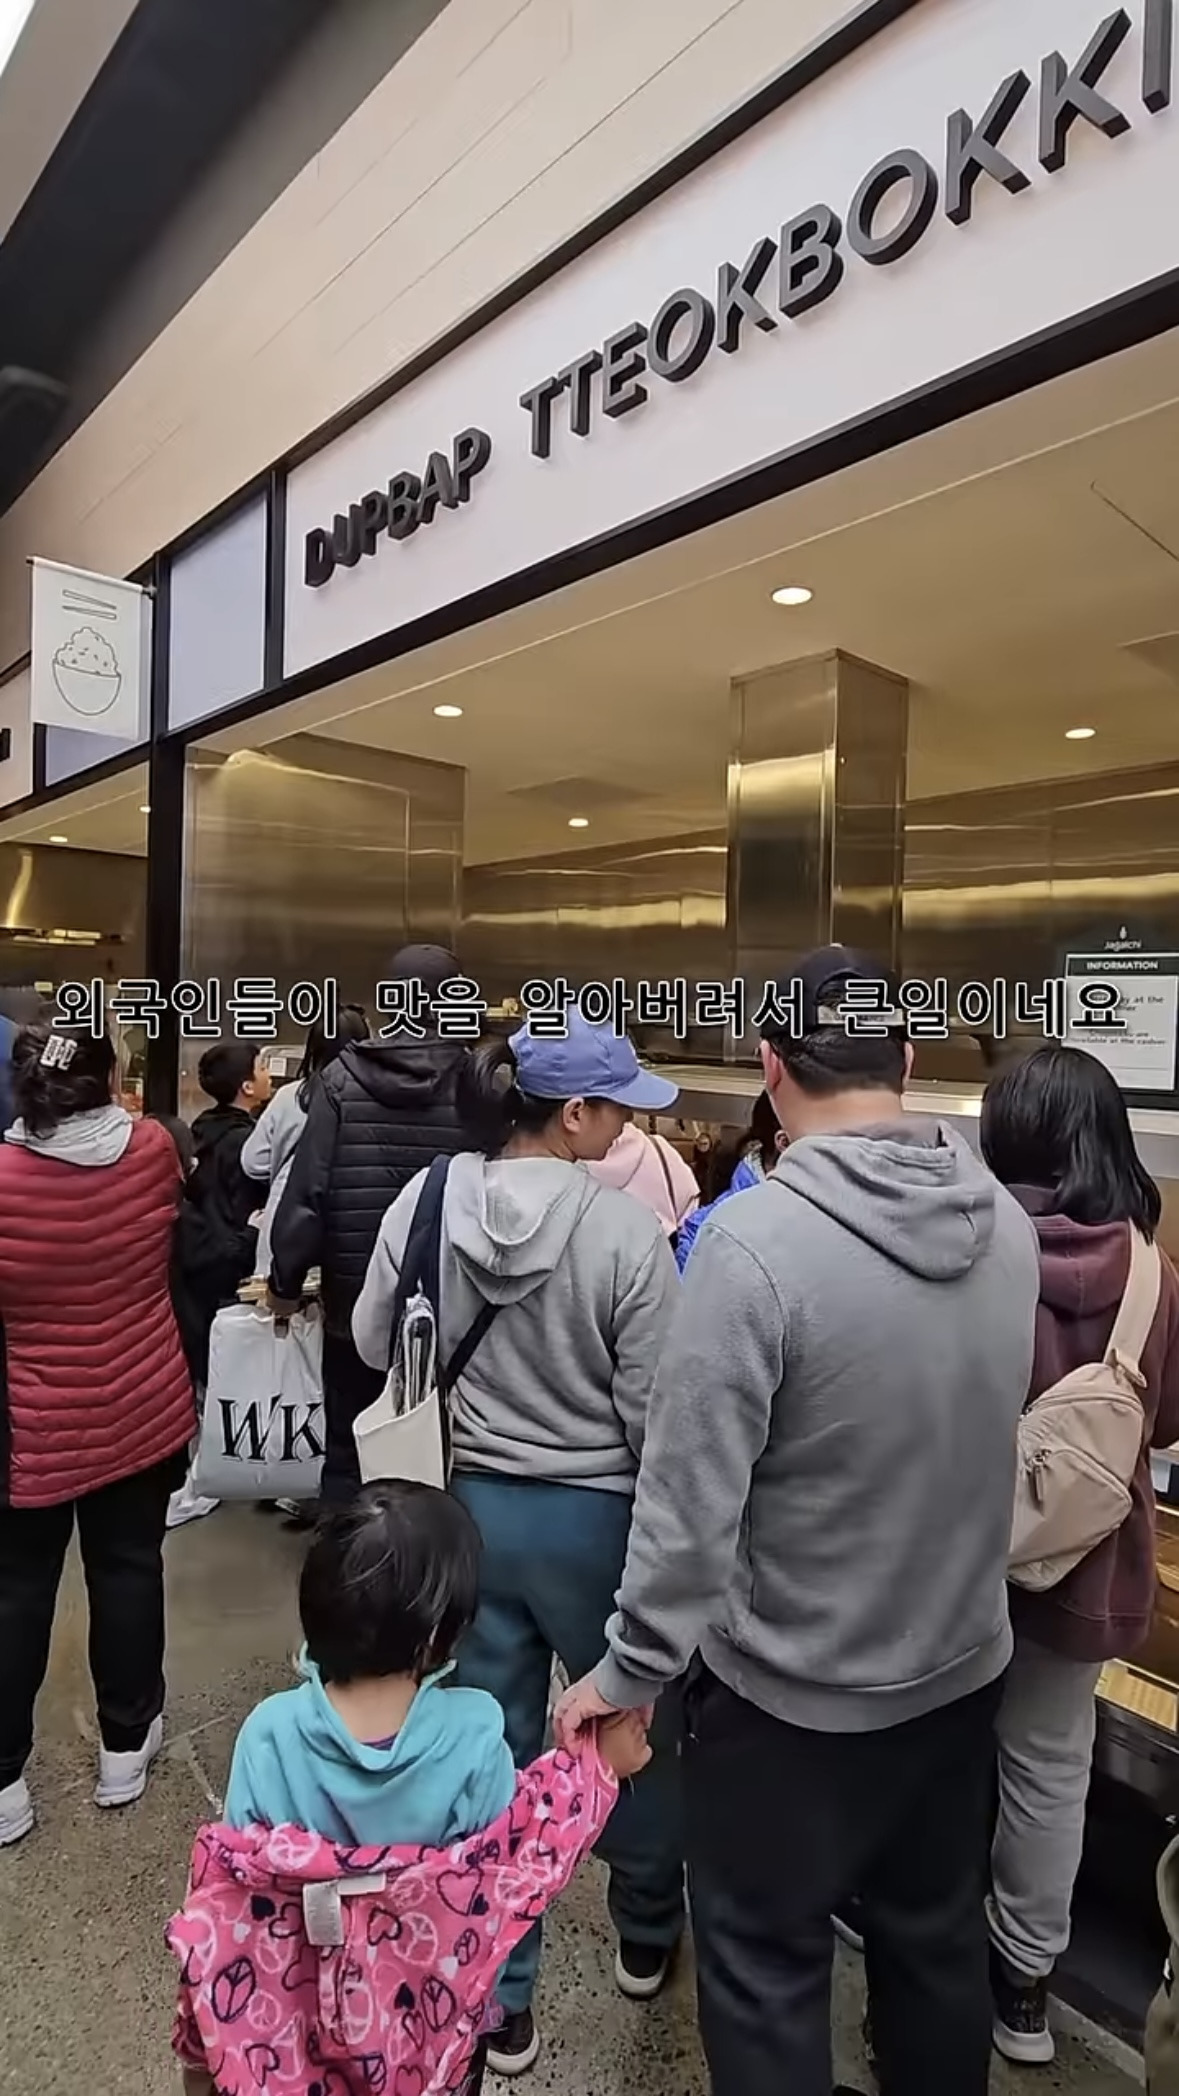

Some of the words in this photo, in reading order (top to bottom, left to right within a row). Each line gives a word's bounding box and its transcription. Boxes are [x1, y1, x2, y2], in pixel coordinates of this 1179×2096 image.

[305, 427, 492, 588] DUPBAP
[519, 0, 1173, 460] TTEOKBOKKI
[1086, 961, 1159, 970] INFORMATION
